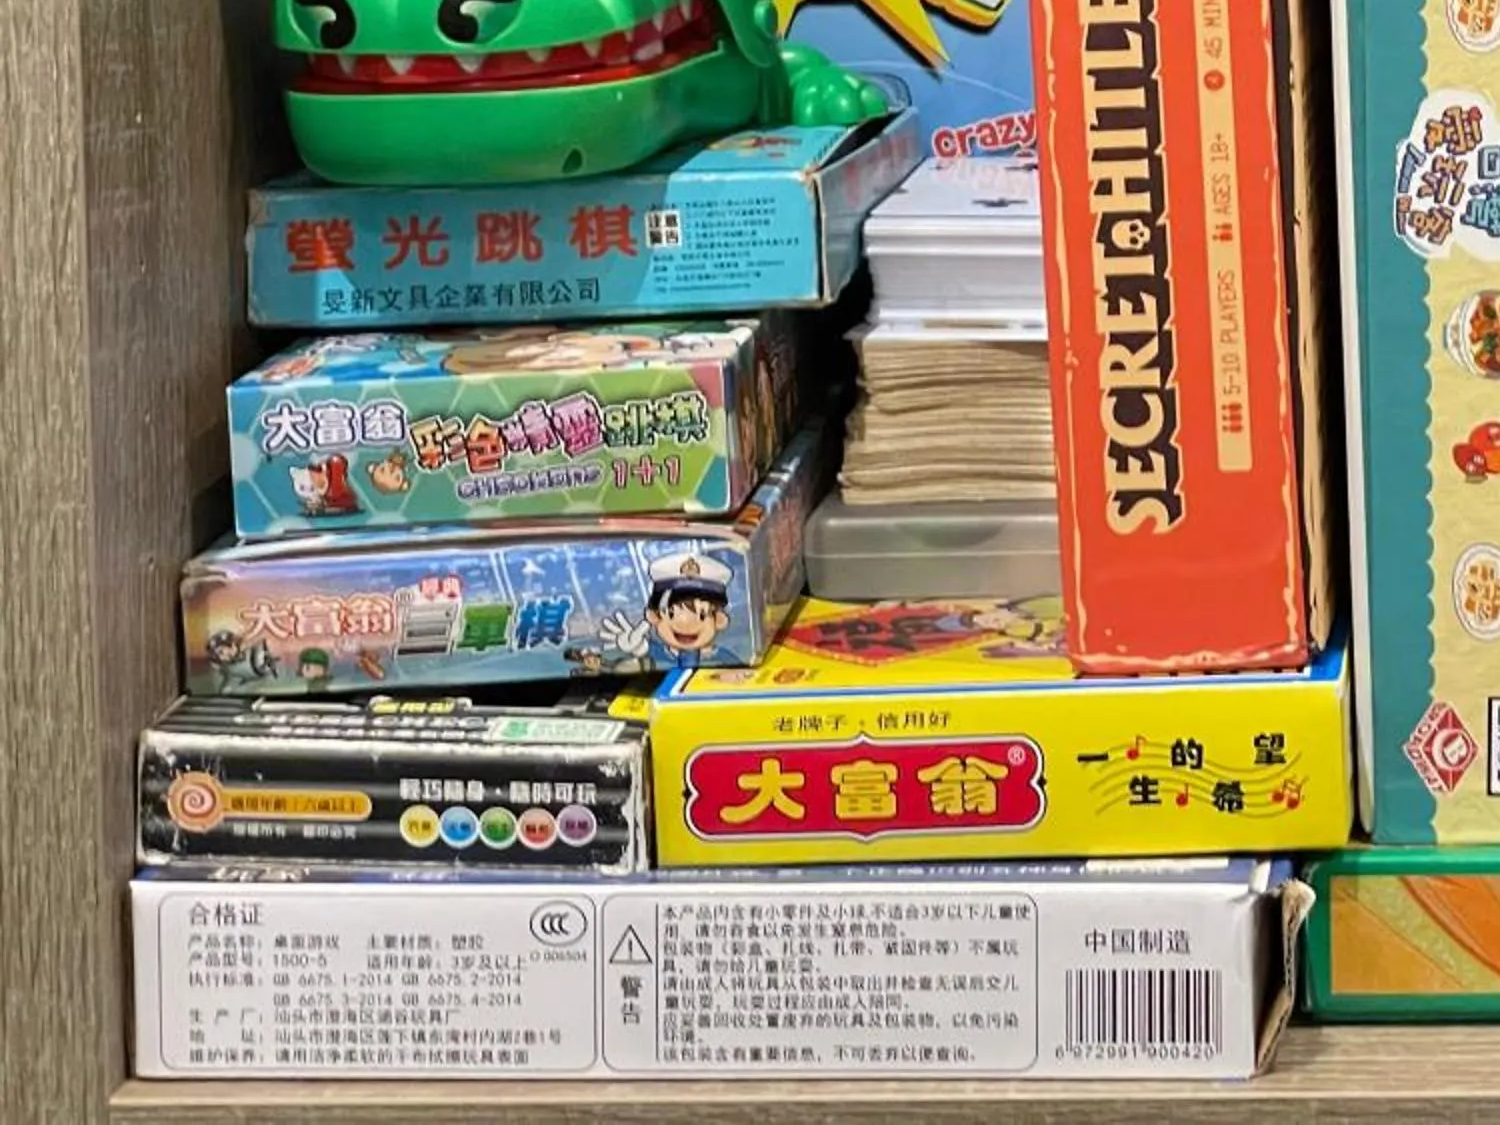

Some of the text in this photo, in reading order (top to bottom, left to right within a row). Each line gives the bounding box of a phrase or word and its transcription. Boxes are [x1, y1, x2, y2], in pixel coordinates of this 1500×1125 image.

[1205, 35, 1221, 59] 45
[1212, 132, 1230, 214] AGES 18+
[286, 203, 639, 274] 螢光跳棋
[1219, 269, 1236, 396] 5-10 PLAYERS
[1097, 227, 1186, 535] SECRET
[262, 400, 405, 451] 大富翁
[611, 458, 682, 490] 1+1
[242, 594, 395, 639] 大富翁
[718, 757, 1009, 824] 大富翁
[188, 902, 265, 928] 合格证
[1084, 928, 1192, 955] 中国制造
